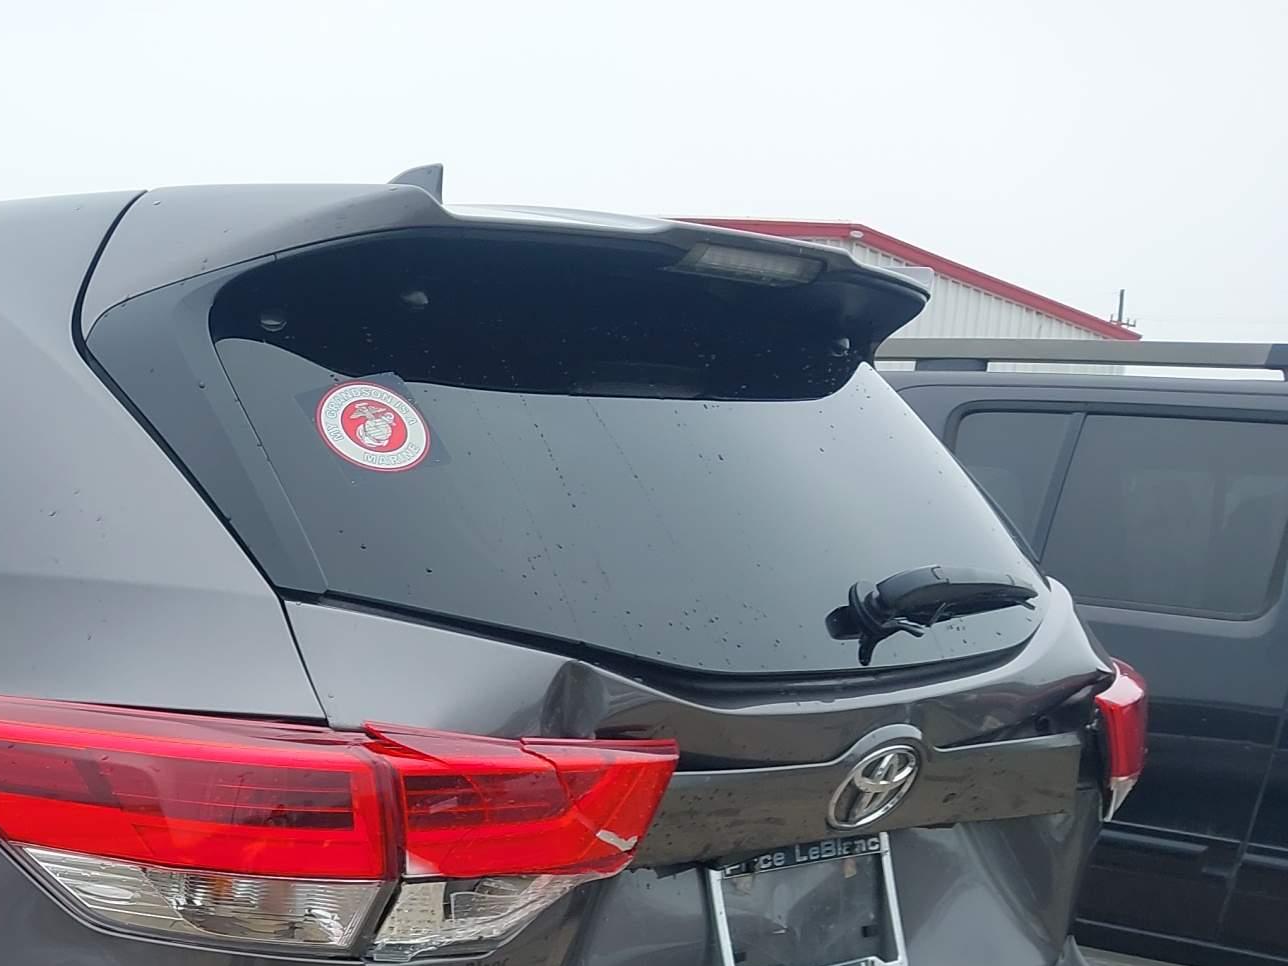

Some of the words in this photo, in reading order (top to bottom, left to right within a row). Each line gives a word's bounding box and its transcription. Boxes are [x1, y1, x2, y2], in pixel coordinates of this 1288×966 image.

[326, 387, 393, 419] GRANDSON
[394, 401, 410, 416] IS
[326, 424, 345, 442] MY
[364, 442, 421, 466] MARINE
